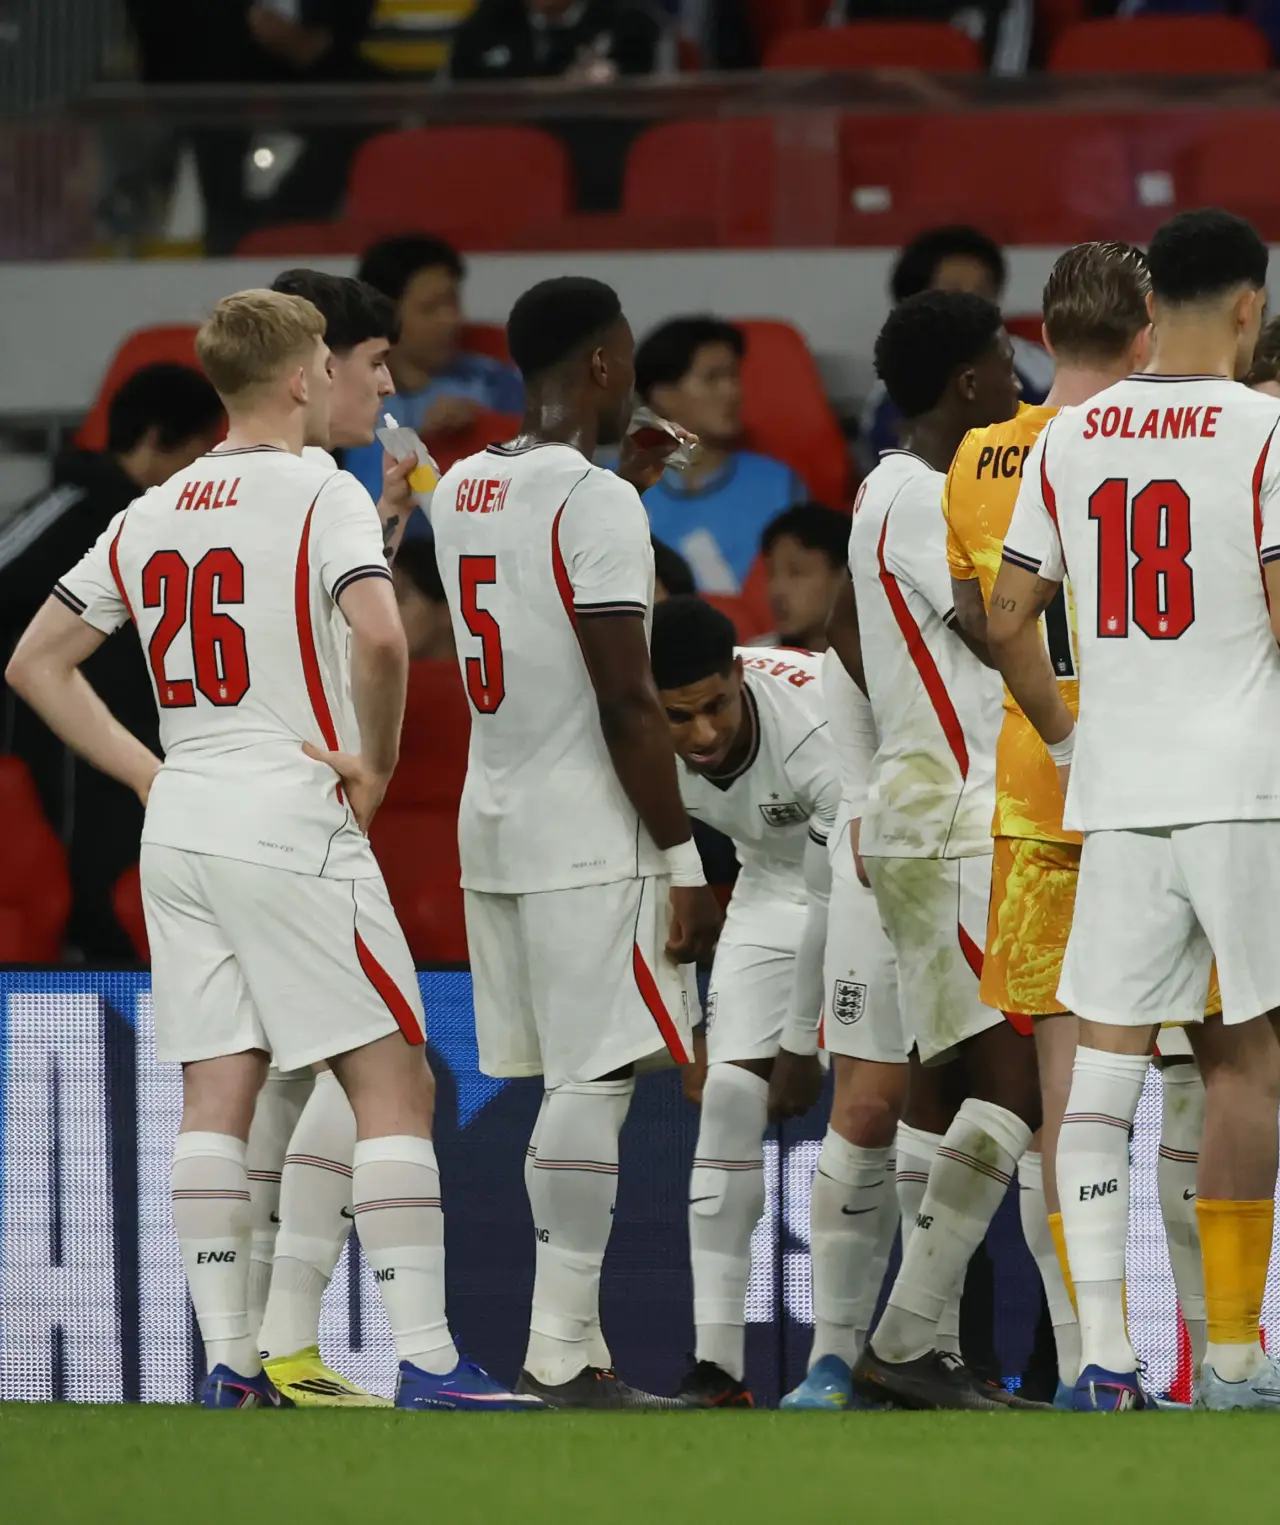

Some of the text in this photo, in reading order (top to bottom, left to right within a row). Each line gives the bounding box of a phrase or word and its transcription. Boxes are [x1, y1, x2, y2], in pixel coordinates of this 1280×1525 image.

[1083, 406, 1223, 440] SOLANKE
[175, 477, 241, 511] HALL
[1088, 477, 1195, 640] 18
[142, 547, 250, 708] 26
[459, 555, 505, 714] 5
[1079, 1179, 1118, 1201] ENG
[197, 1250, 236, 1264] ENG
